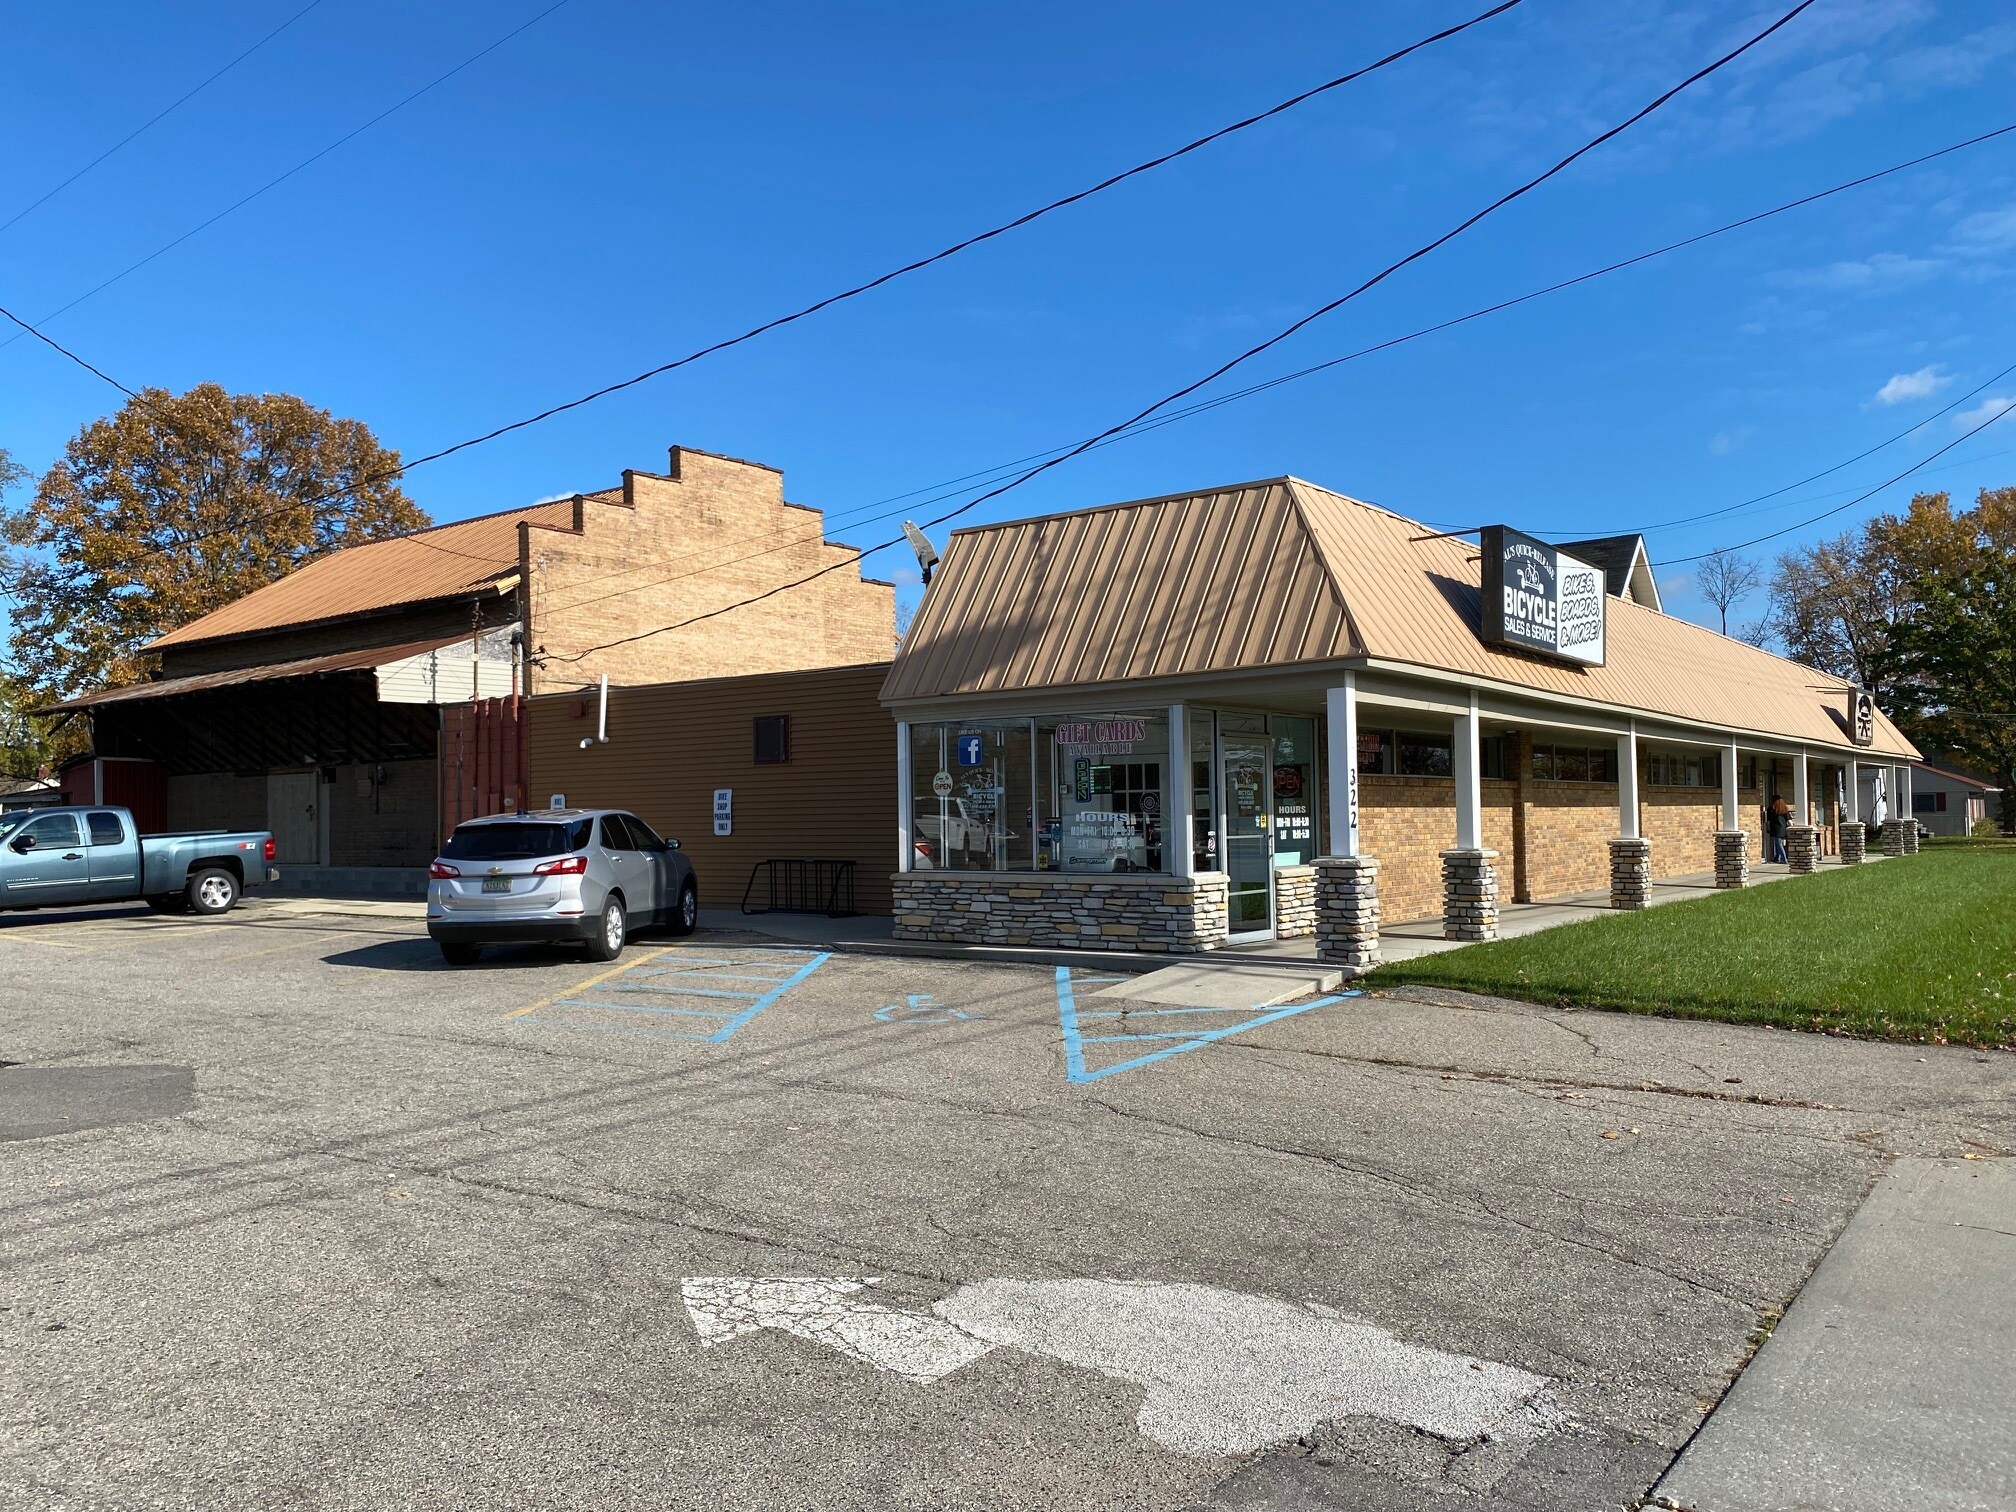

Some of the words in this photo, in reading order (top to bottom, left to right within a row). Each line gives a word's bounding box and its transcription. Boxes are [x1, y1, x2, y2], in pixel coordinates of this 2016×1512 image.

[1562, 573, 1596, 597] BIKES,
[1504, 585, 1556, 628] BICYCLE
[1560, 596, 1600, 622] BOARDS,
[1504, 616, 1525, 636] SALES
[1525, 622, 1532, 638] &
[1532, 624, 1556, 645] SERVICE
[1560, 626, 1571, 648] &
[1569, 619, 1602, 645] MORE!
[1056, 723, 1091, 744] GIFT
[1095, 720, 1146, 742] CARDS
[1069, 743, 1132, 755] AVAILABLE
[1076, 761, 1088, 800] OPEN
[717, 803, 728, 811] SHOP
[1279, 806, 1307, 814] HOURS
[715, 812, 731, 821] PARKING
[1075, 813, 1128, 822] HOURS
[718, 823, 728, 831] ONLY
[1078, 839, 1090, 850] SAT
